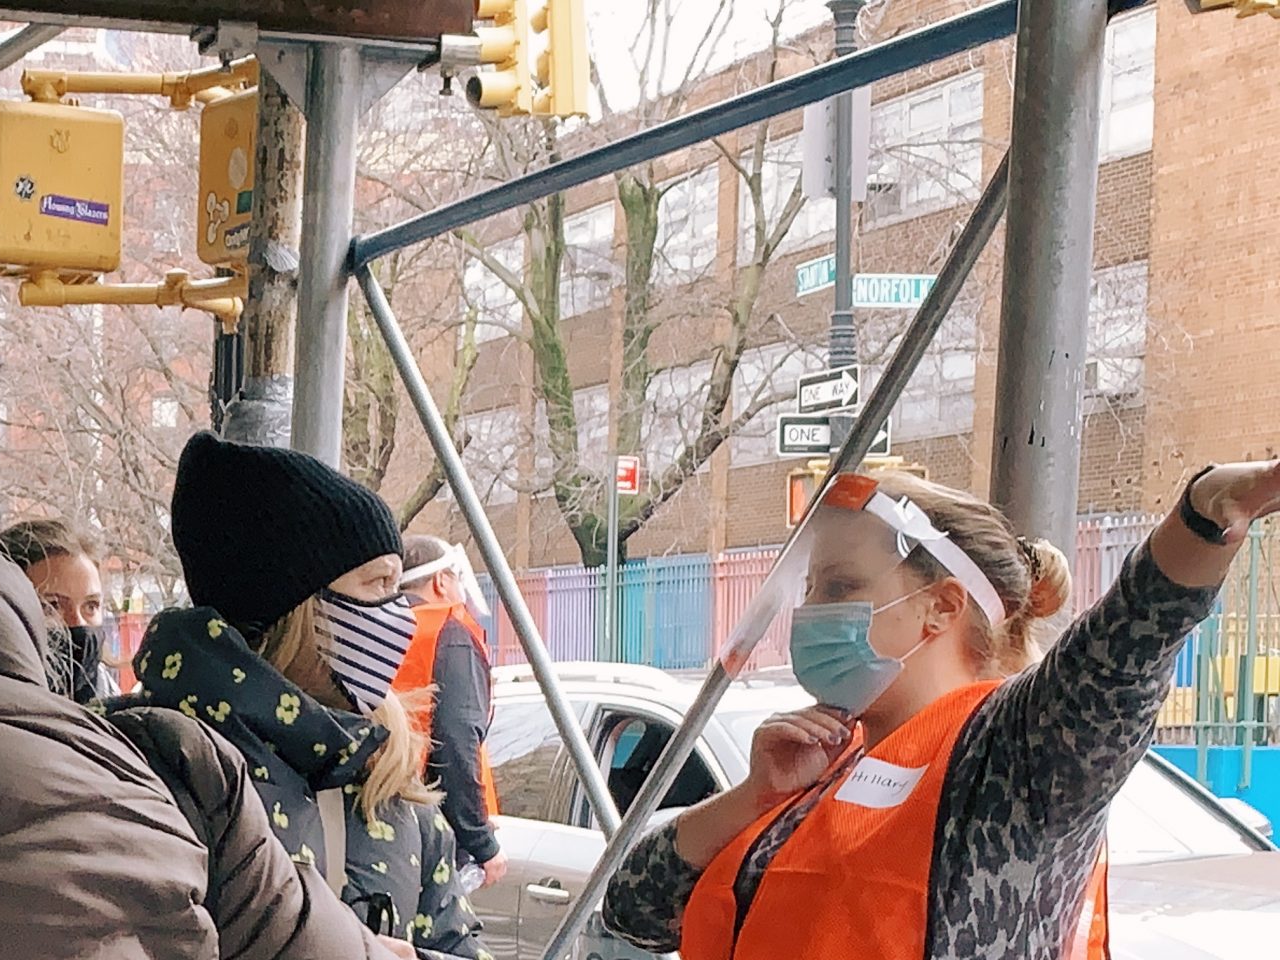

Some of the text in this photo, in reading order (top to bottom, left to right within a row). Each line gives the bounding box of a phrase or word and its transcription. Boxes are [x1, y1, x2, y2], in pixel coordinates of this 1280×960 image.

[804, 381, 850, 403] ONE WAY
[789, 427, 821, 442] ONE
